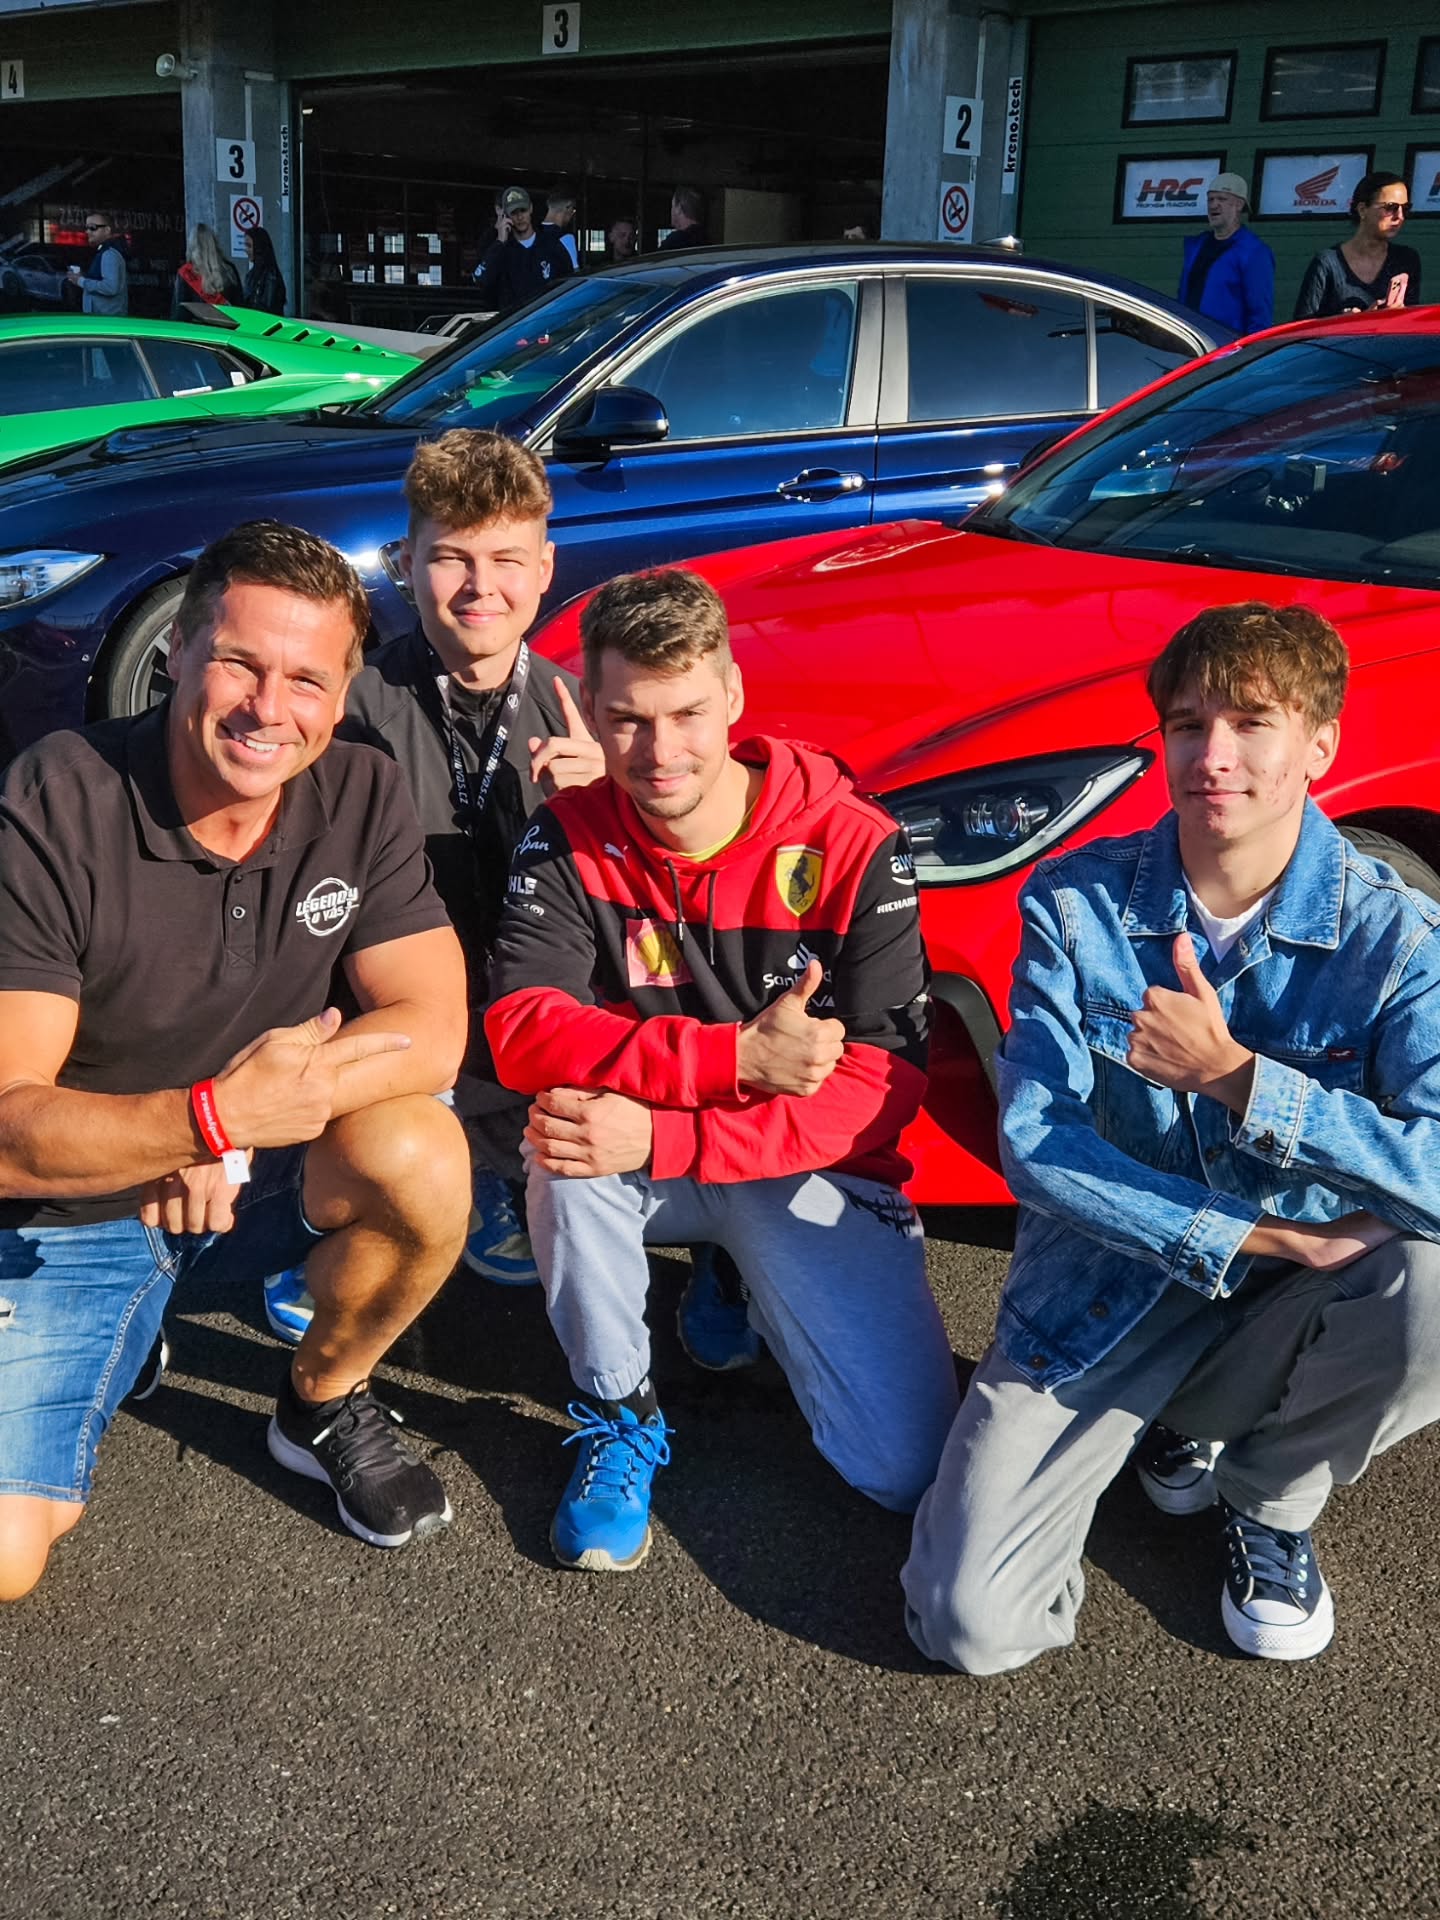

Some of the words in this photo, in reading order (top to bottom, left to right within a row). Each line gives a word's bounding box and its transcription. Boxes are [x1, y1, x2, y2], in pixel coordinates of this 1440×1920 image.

[554, 9, 568, 48] 3
[8, 64, 17, 94] 4
[955, 104, 972, 149] 2
[1004, 79, 1021, 172] kreno.tech
[229, 144, 244, 178] 3
[1136, 178, 1204, 202] HRC
[1293, 199, 1337, 207] HONDA
[508, 875, 537, 895] HLE
[296, 887, 359, 916] LEGENDY
